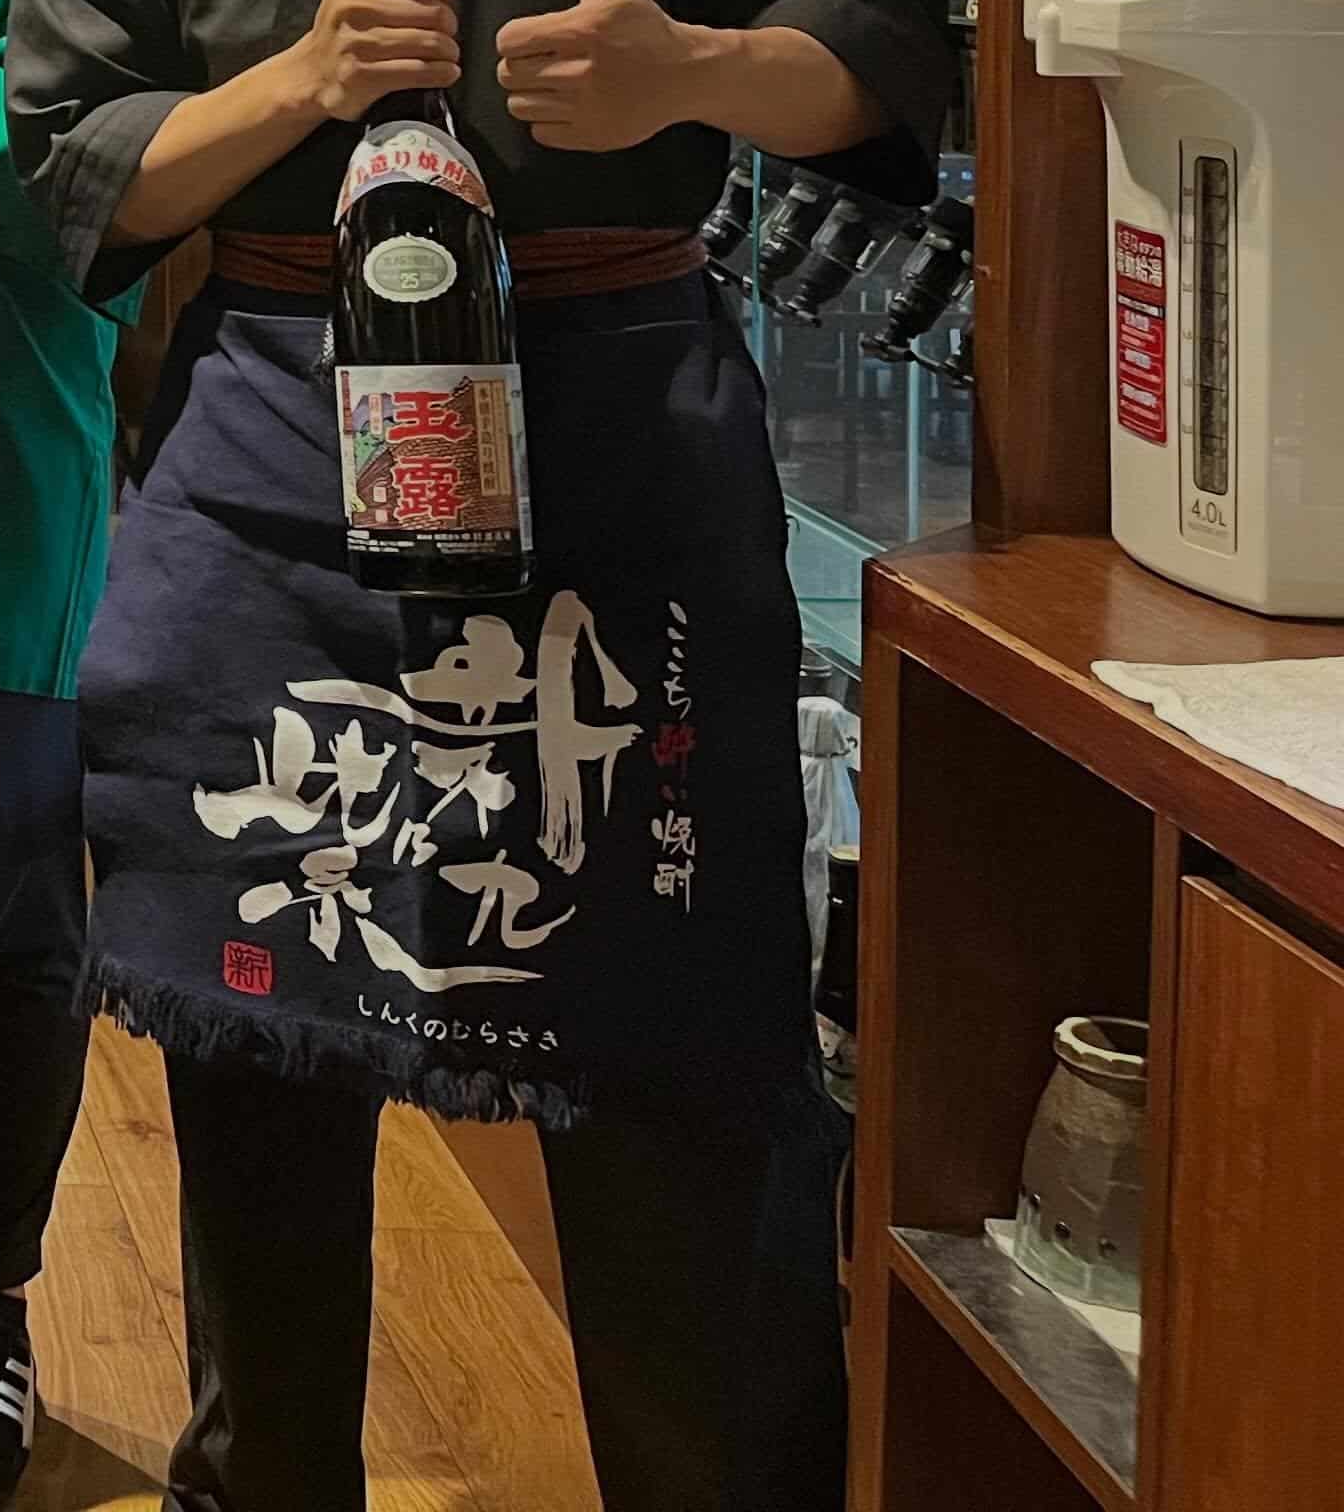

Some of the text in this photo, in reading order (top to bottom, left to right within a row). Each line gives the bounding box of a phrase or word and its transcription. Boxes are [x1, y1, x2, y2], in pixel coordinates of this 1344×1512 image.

[386, 390, 477, 518] 玉露
[1191, 499, 1228, 528] 4.0L
[357, 993, 560, 1051] しんくのむらさき
